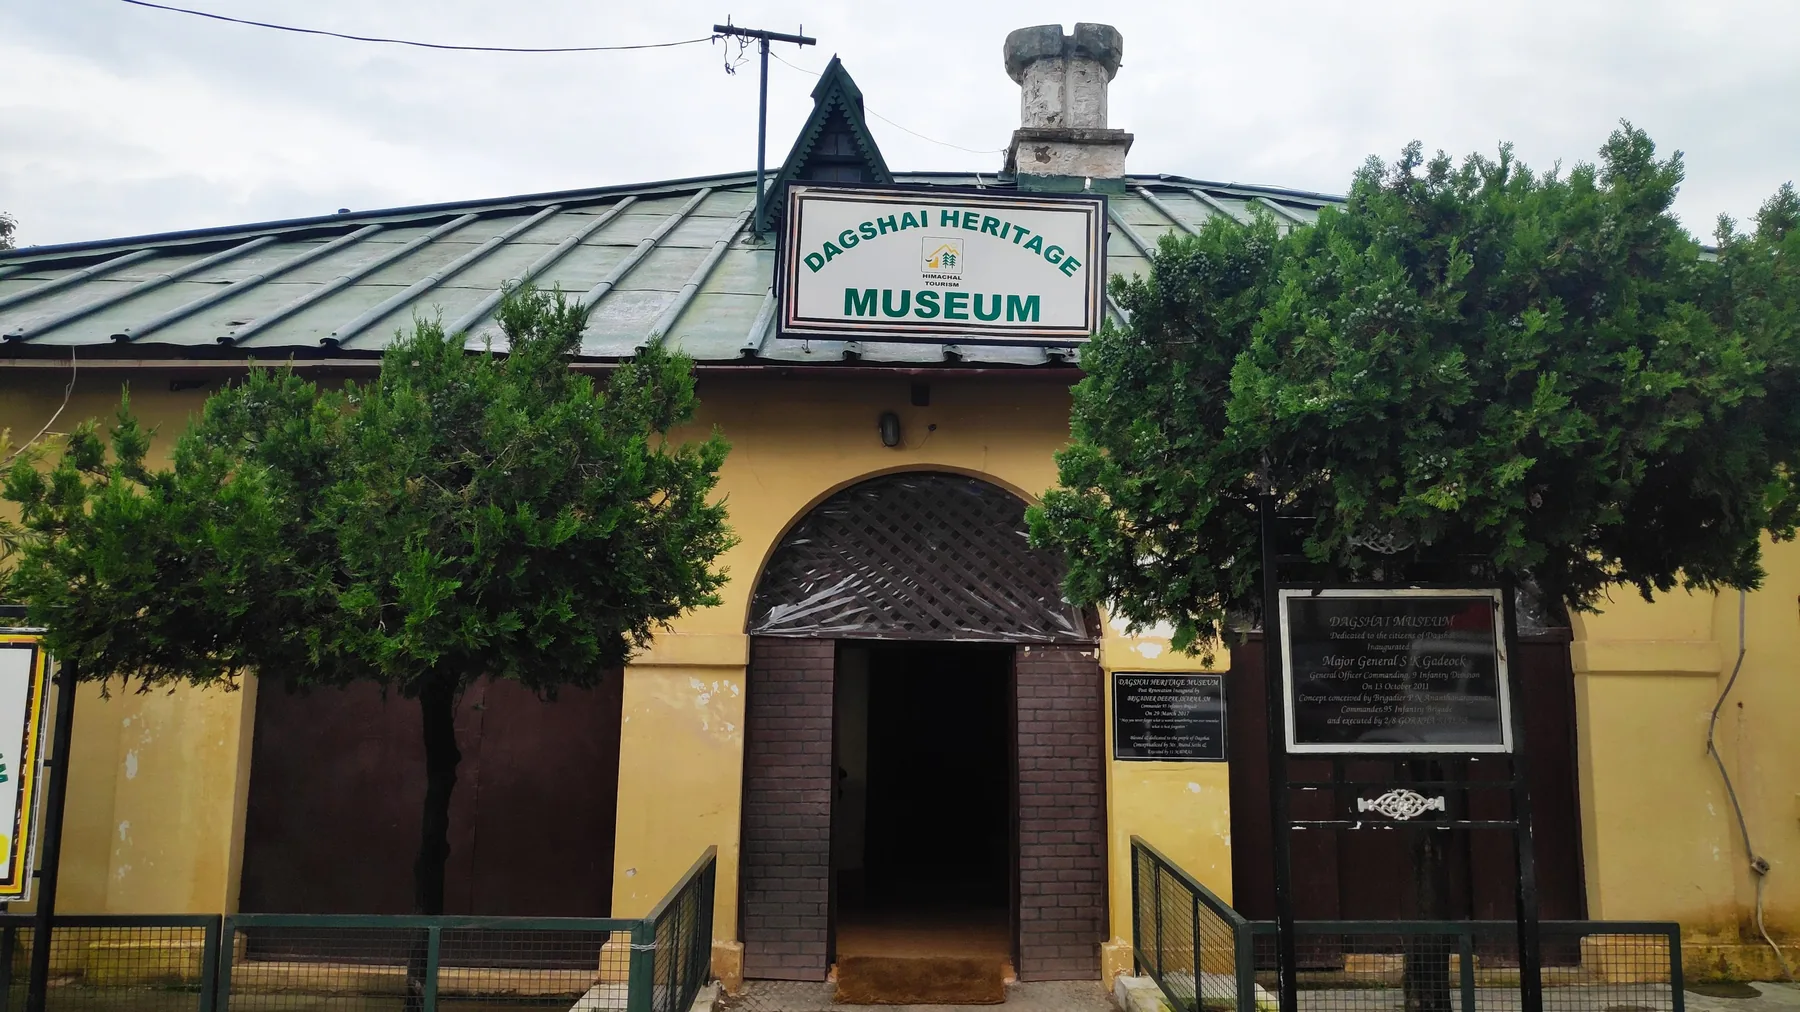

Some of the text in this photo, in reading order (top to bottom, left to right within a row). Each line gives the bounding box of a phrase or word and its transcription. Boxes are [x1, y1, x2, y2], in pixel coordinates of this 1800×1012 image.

[803, 210, 1082, 277] DAGSHAI HERITAGE
[844, 288, 1040, 322] MUSEUM
[1329, 615, 1456, 629] DAGSHAI MUSEUM
[1417, 632, 1425, 641] of
[1367, 643, 1410, 652] Inaugurated
[1322, 655, 1466, 670] Major General S K Gadeock
[1309, 670, 1337, 681] General
[1338, 670, 1362, 681] Officer
[1420, 671, 1449, 680] Infantry
[1118, 679, 1149, 687] DAGSHAI
[1150, 679, 1186, 687] HERITAGE
[1384, 682, 1412, 690] October
[1298, 694, 1326, 704] Concept
[1328, 694, 1362, 702] conceived
[1363, 693, 1372, 704] by
[1372, 694, 1406, 704] Brigadier
[1394, 706, 1424, 715] Infantry
[1425, 705, 1452, 715] Brigade
[1342, 716, 1372, 726] executed
[1374, 716, 1383, 726] by
[1384, 717, 1396, 726] 2/8
